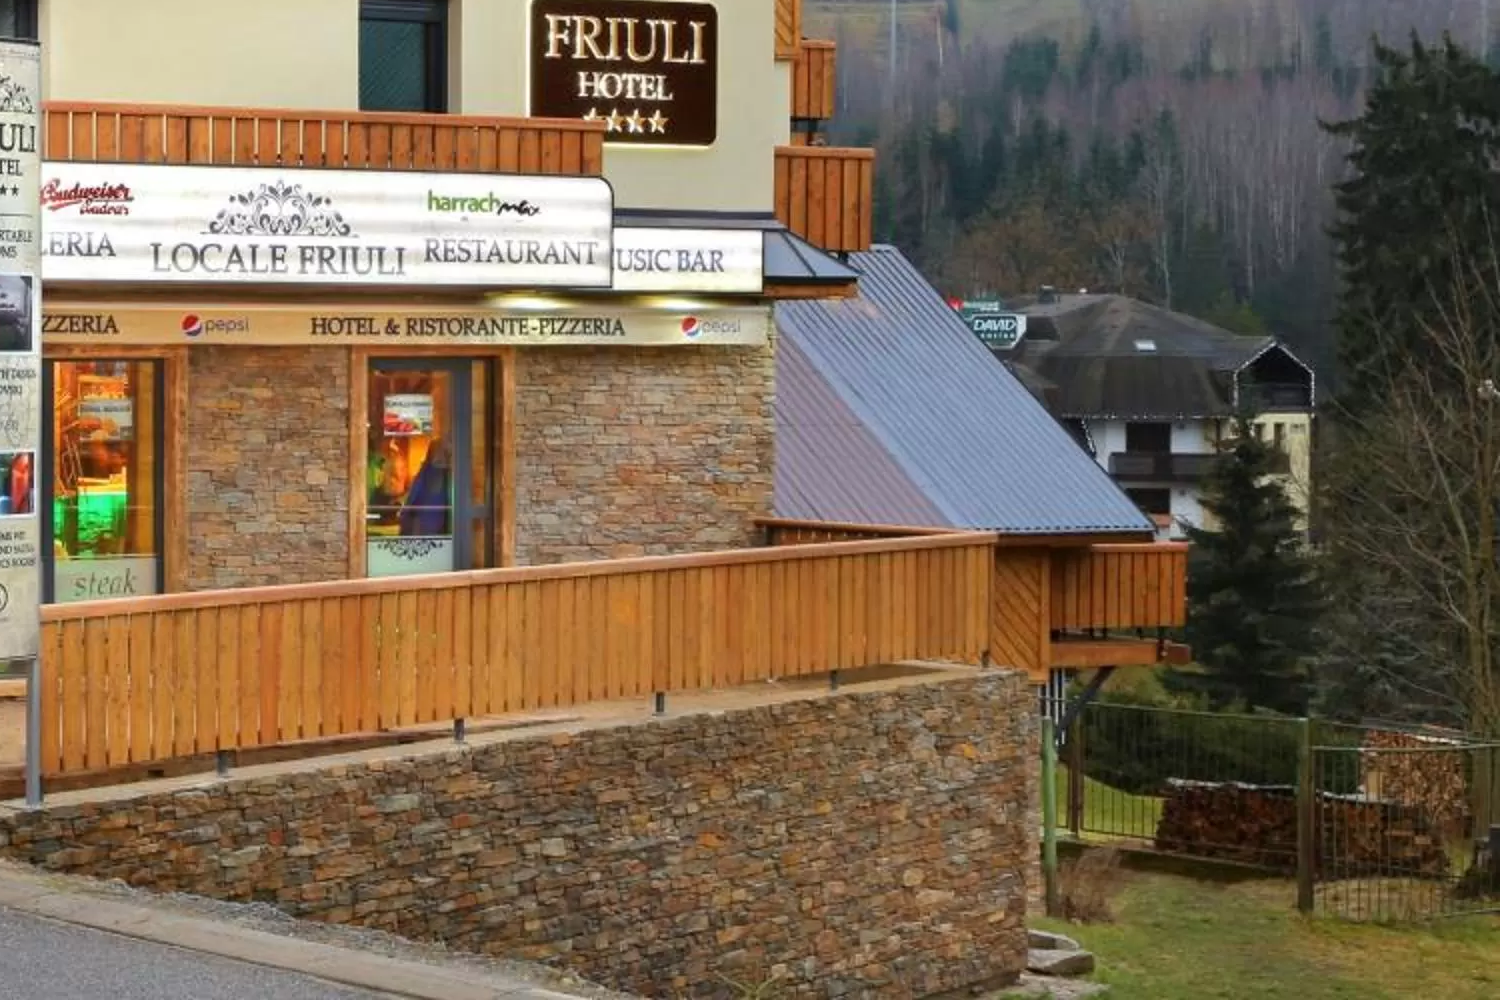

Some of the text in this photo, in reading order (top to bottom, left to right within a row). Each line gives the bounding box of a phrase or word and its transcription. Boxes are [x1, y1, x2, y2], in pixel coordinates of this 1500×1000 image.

[544, 13, 707, 64] FRIULI
[577, 71, 674, 101] HOTEL
[41, 231, 598, 276] ERIA LOCALE FRIULI RESTAURANT
[676, 249, 725, 273] BAR
[205, 317, 250, 334] pepsi
[311, 317, 380, 335] HOTEL
[385, 317, 402, 335] &
[406, 317, 626, 337] RISTORANTE-PIZZERIA
[973, 318, 1017, 331] DAVID
[74, 567, 137, 597] steak
